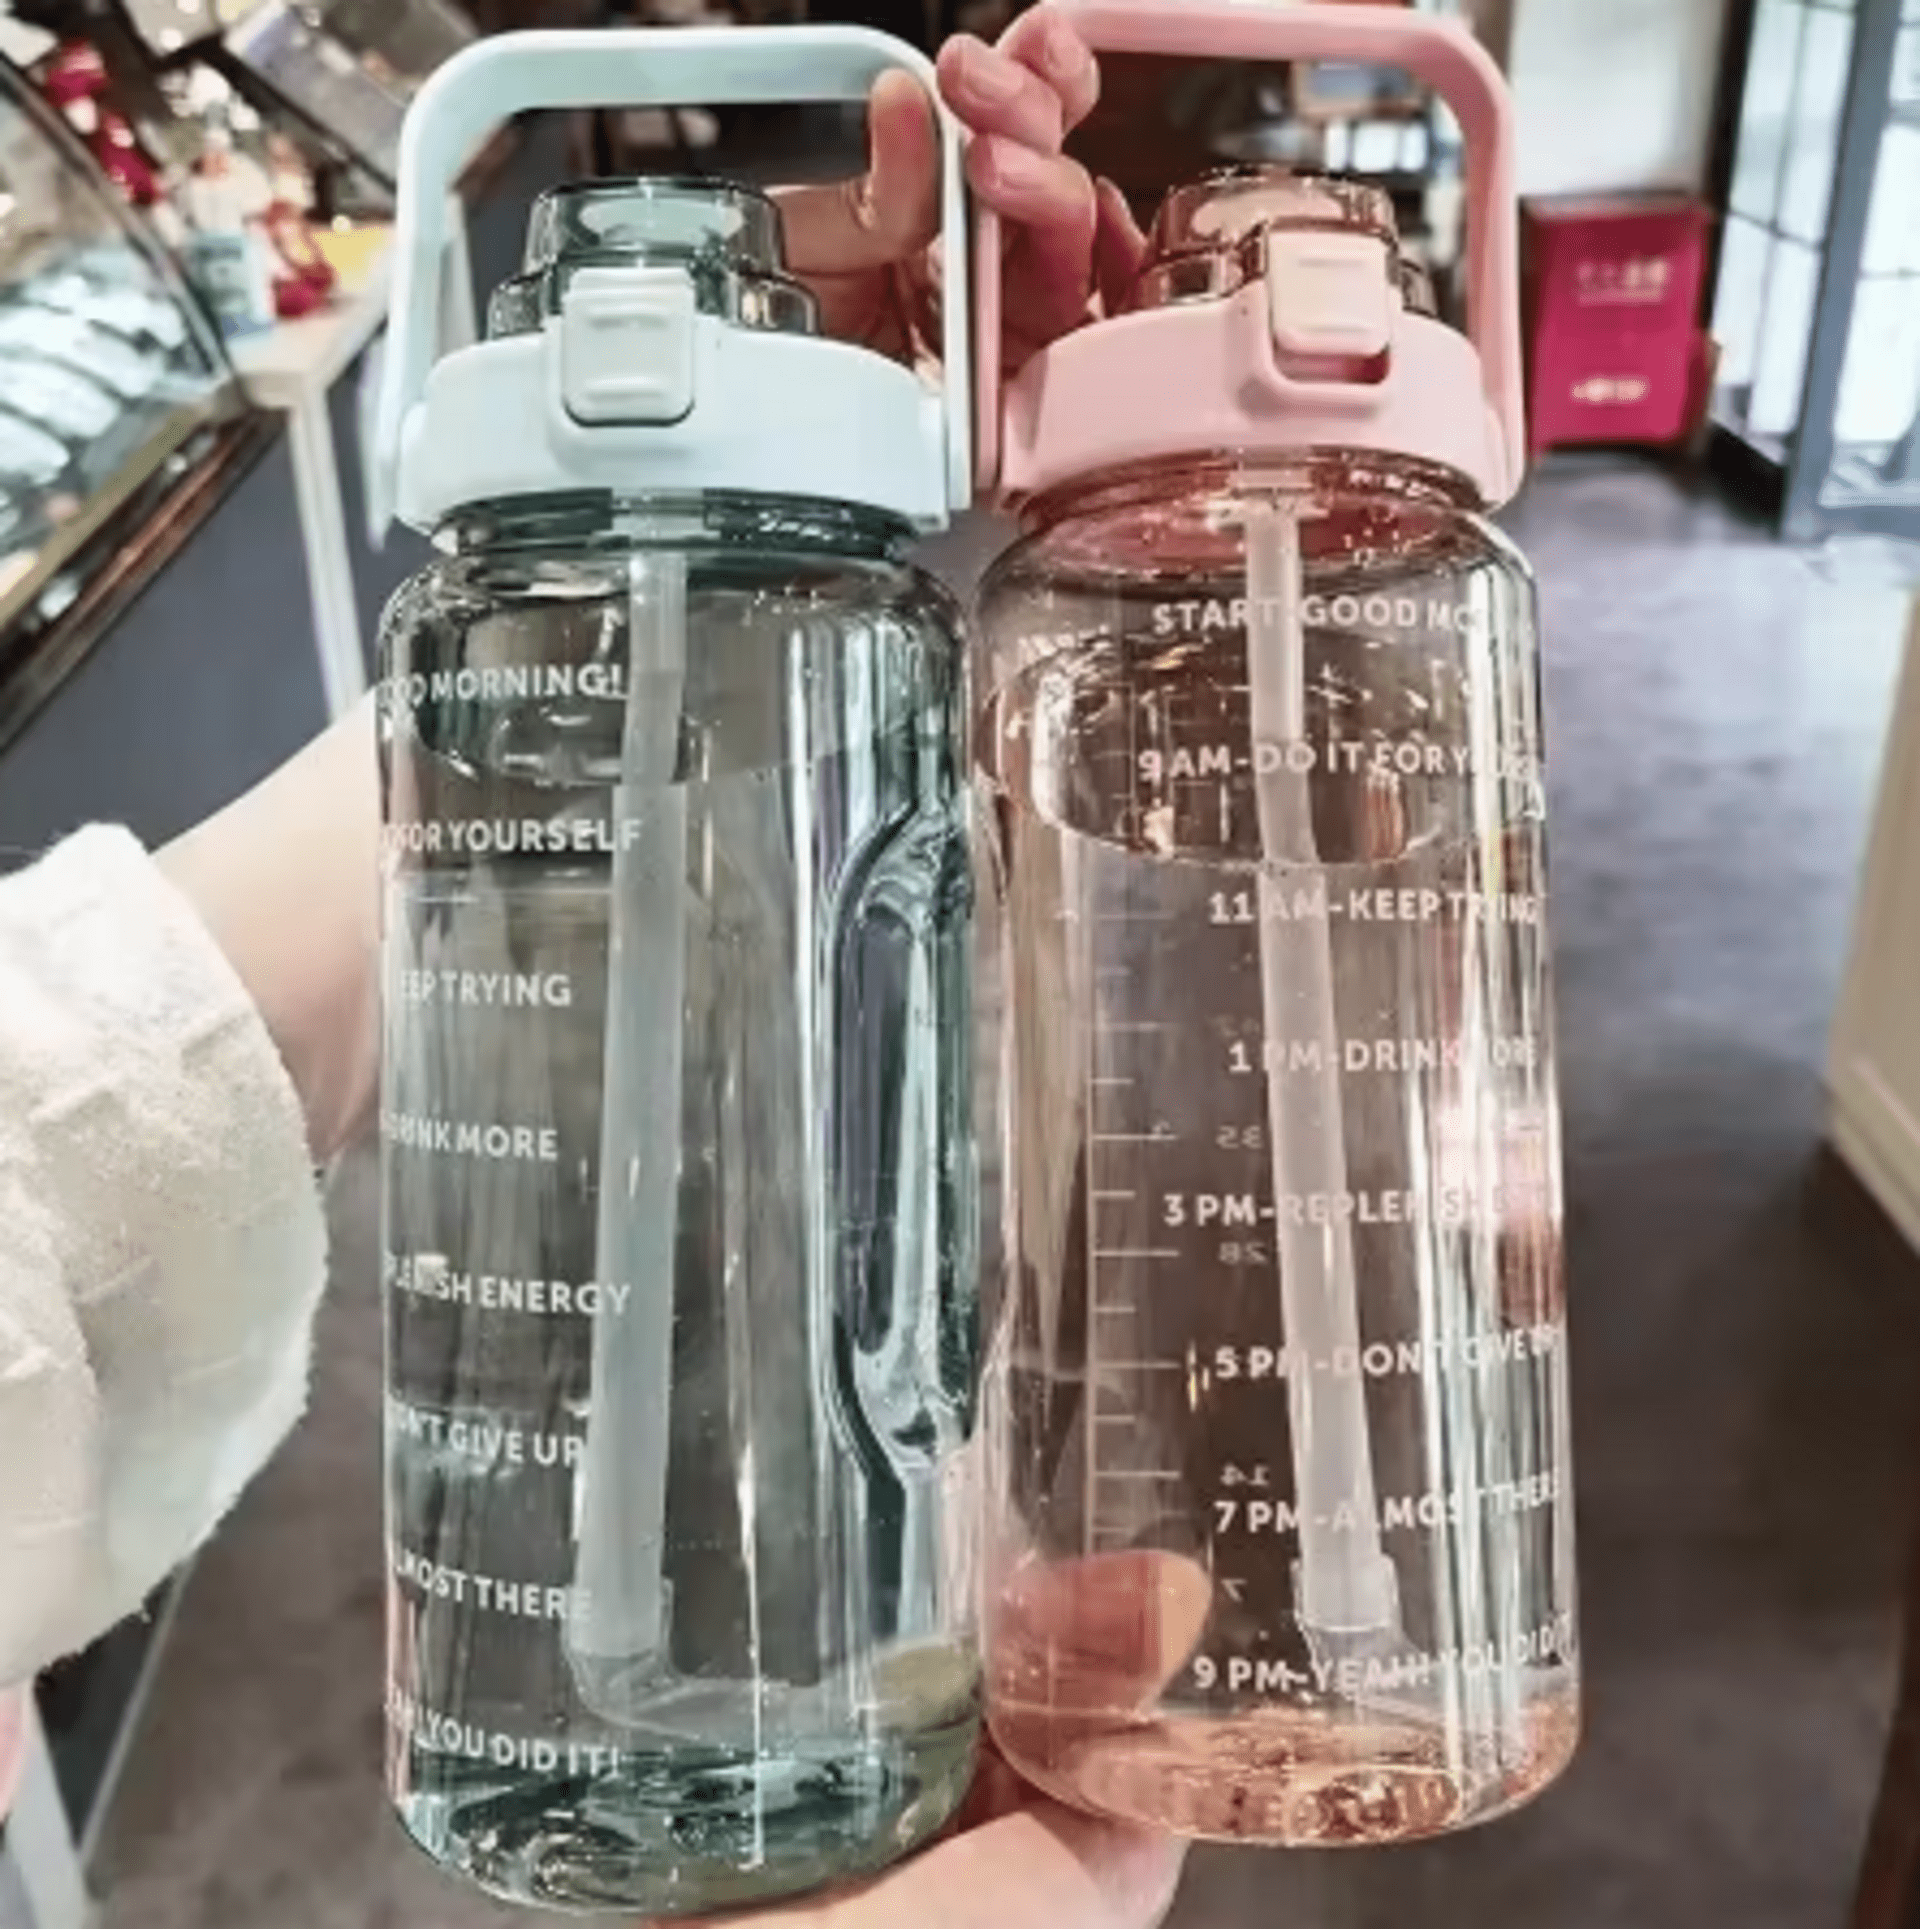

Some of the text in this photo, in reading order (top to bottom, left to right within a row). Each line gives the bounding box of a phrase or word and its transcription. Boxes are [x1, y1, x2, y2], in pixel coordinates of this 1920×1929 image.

[1300, 595, 1418, 627] GOOD
[430, 663, 622, 703] MORNING!
[1327, 741, 1364, 773] IT
[1373, 741, 1446, 774] FOR
[448, 817, 643, 852] YOURSELF
[1208, 890, 1255, 925] 11
[439, 971, 572, 1008] TRYING
[1229, 1039, 1252, 1073] 1
[456, 1121, 559, 1162] MORE
[1163, 1193, 1185, 1226] 3
[478, 1275, 632, 1316] ENERGY
[1215, 1347, 1240, 1379] 5
[449, 1419, 525, 1465] GIVE
[533, 1430, 585, 1469] UP
[1215, 1501, 1237, 1534] 7
[473, 1573, 593, 1624] THERE
[1193, 1655, 1217, 1689] 9
[426, 1707, 485, 1758] YOU
[490, 1733, 558, 1772] DID
